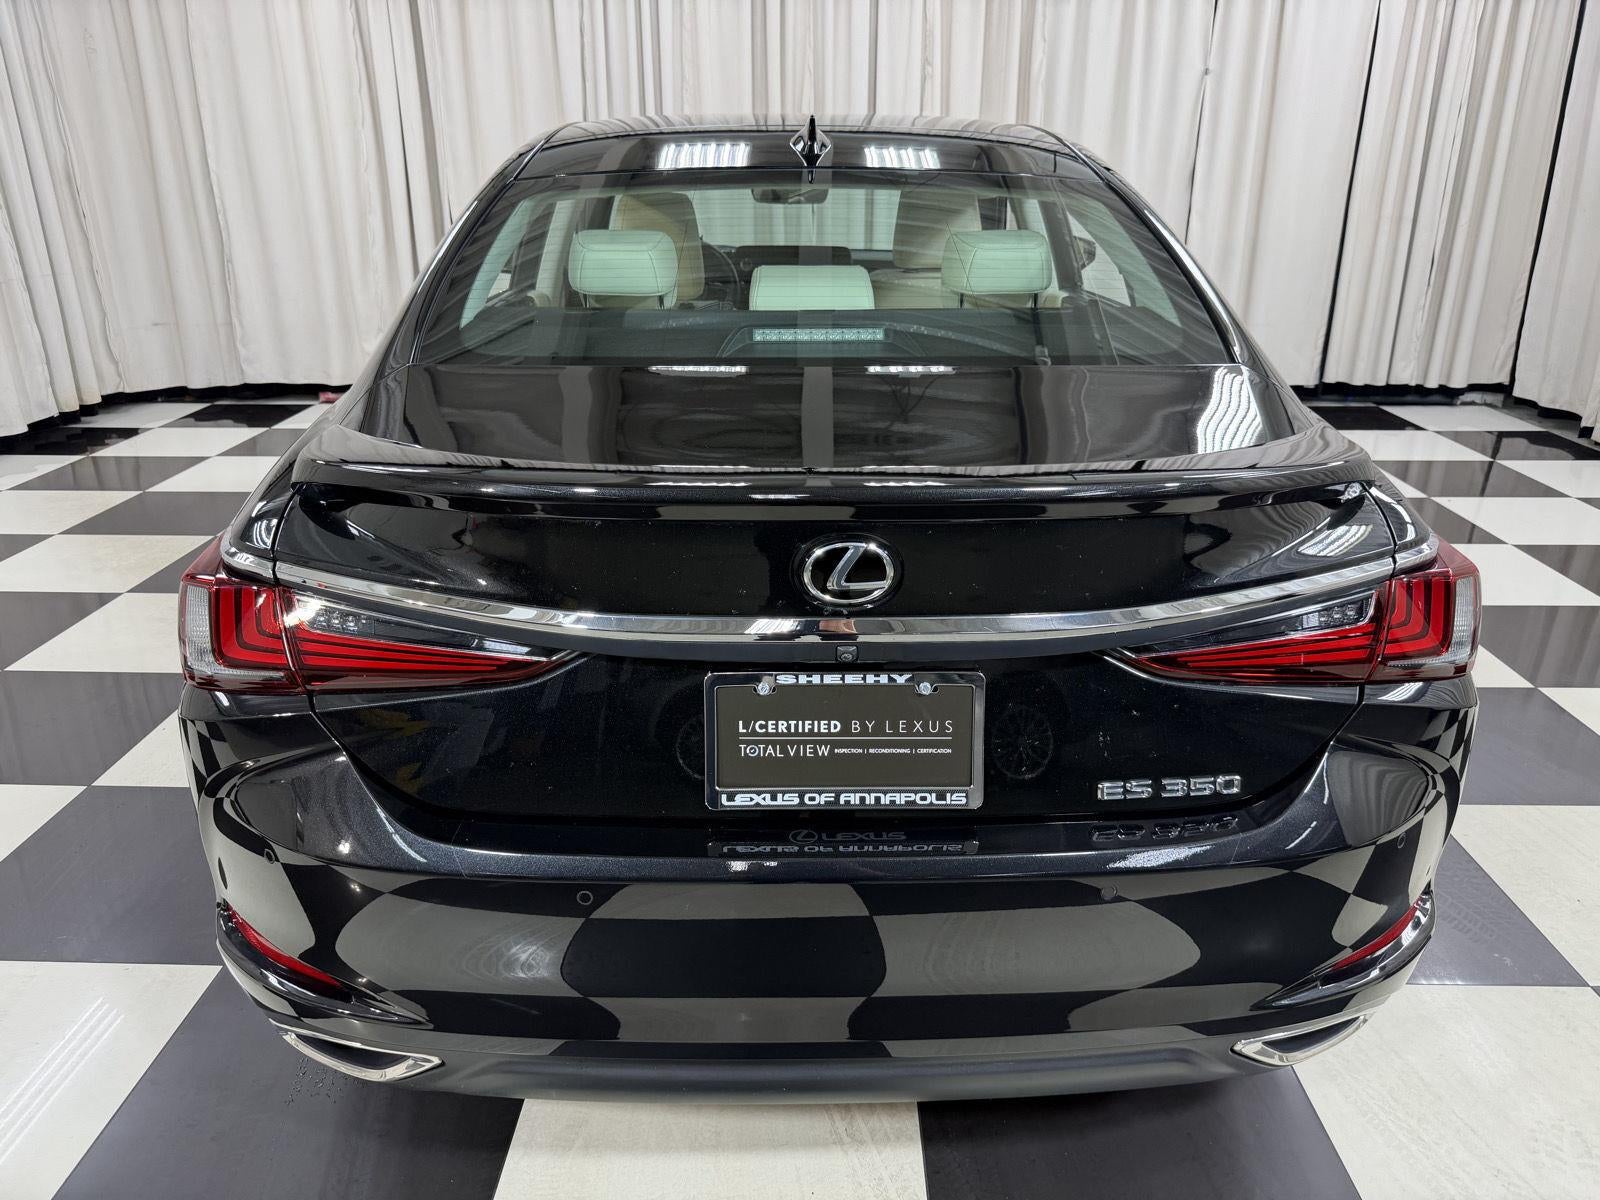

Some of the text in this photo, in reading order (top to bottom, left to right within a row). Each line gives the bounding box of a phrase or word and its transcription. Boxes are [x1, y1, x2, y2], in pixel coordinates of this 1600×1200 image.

[776, 674, 912, 684] SHEEHY
[738, 720, 953, 733] L/CERTIFIED BY LEXUS
[1097, 775, 1241, 800] ES 350
[721, 792, 967, 806] LEXUS OF ANNAPOLIS
[821, 831, 907, 841] LEXUS
